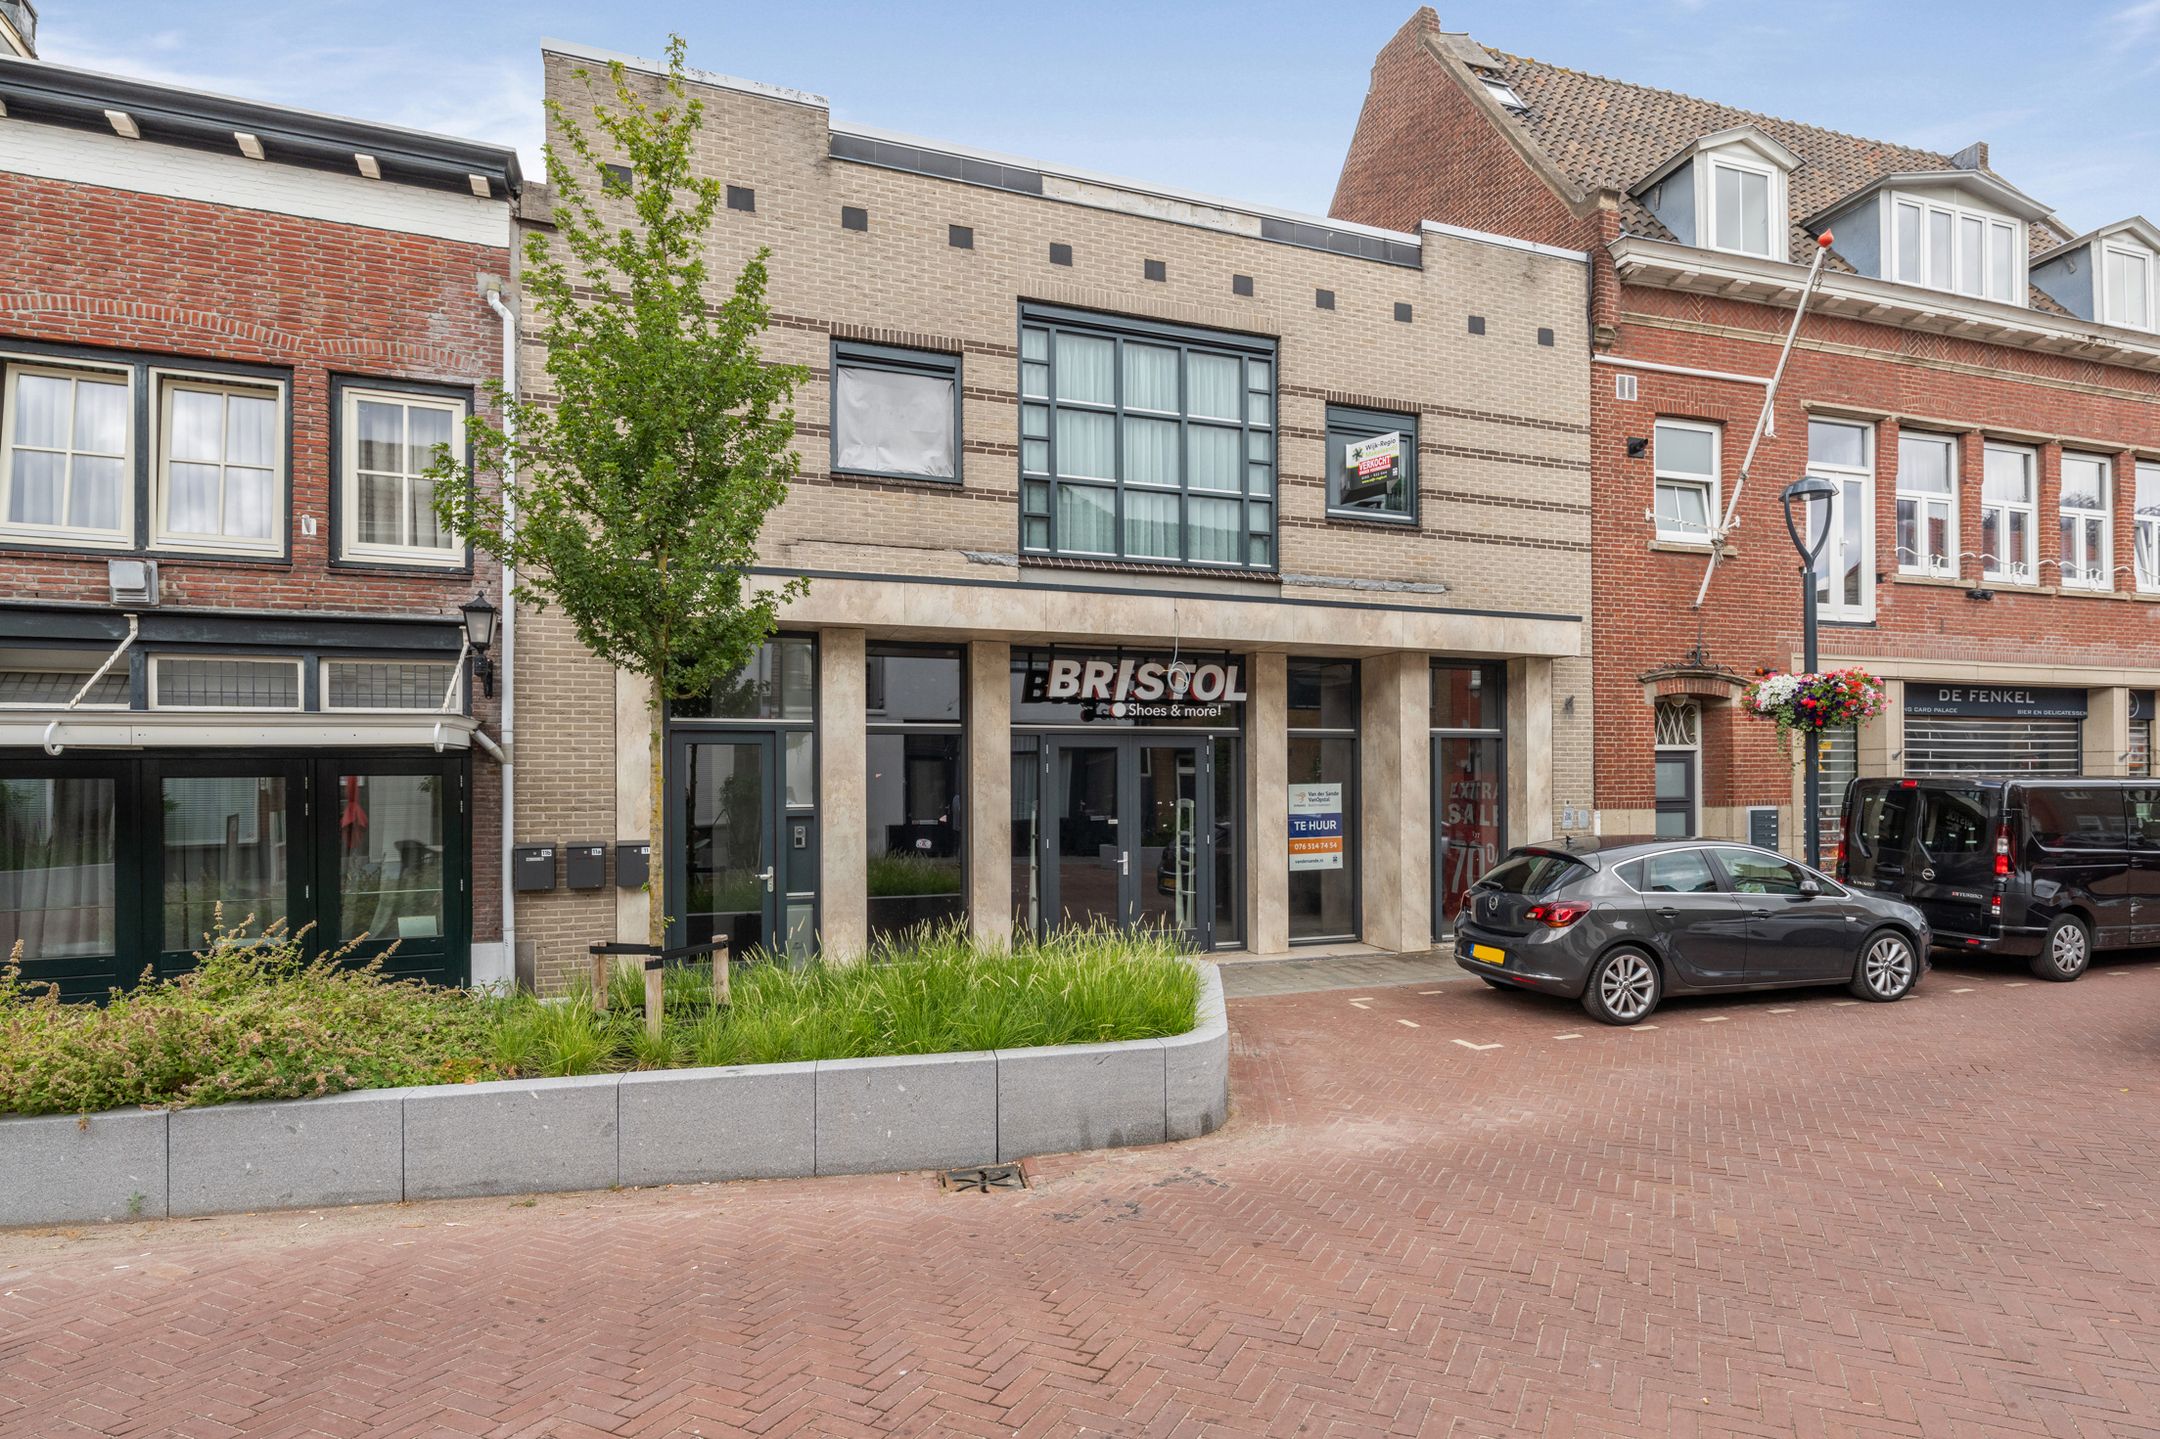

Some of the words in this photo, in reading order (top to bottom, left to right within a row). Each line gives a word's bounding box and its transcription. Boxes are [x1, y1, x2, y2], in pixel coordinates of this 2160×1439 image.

[1365, 438, 1396, 451] Wijk-Regio
[1359, 456, 1391, 471] VERKOCHT
[1046, 659, 1248, 702] BRISTOL
[1938, 689, 1962, 703] DE
[1969, 689, 2035, 704] FENKEL
[1128, 703, 1167, 717] Shoes
[1171, 704, 1181, 717] &
[1184, 704, 1222, 718] more!
[1294, 821, 1307, 831] TE
[1308, 820, 1337, 831] HUUR
[1294, 842, 1307, 850] 076
[1307, 842, 1319, 850] 514
[1329, 841, 1338, 849] 54
